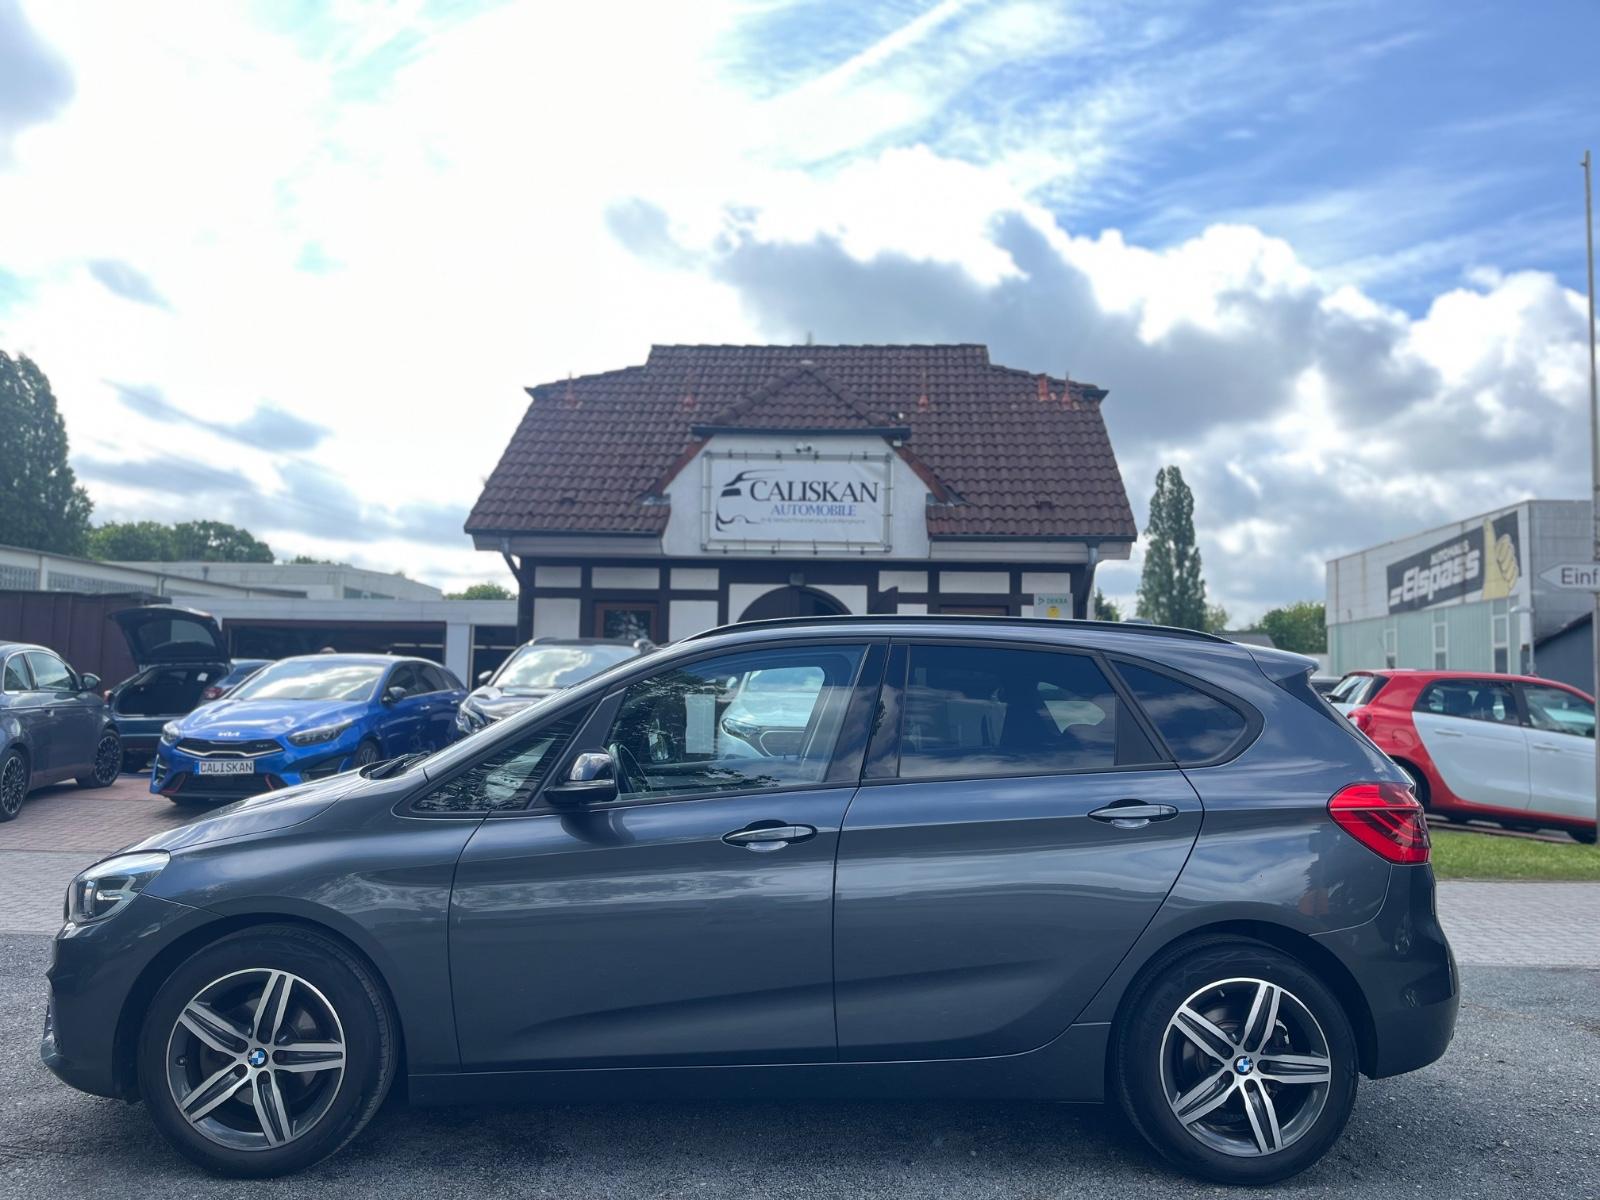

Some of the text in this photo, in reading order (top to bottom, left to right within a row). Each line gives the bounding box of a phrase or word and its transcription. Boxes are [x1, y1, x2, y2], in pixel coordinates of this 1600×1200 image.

[750, 480, 879, 502] CALISKAN
[771, 504, 856, 517] AUTOMOBILE
[1561, 567, 1599, 585] Einf
[200, 761, 254, 773] CALISKAN
